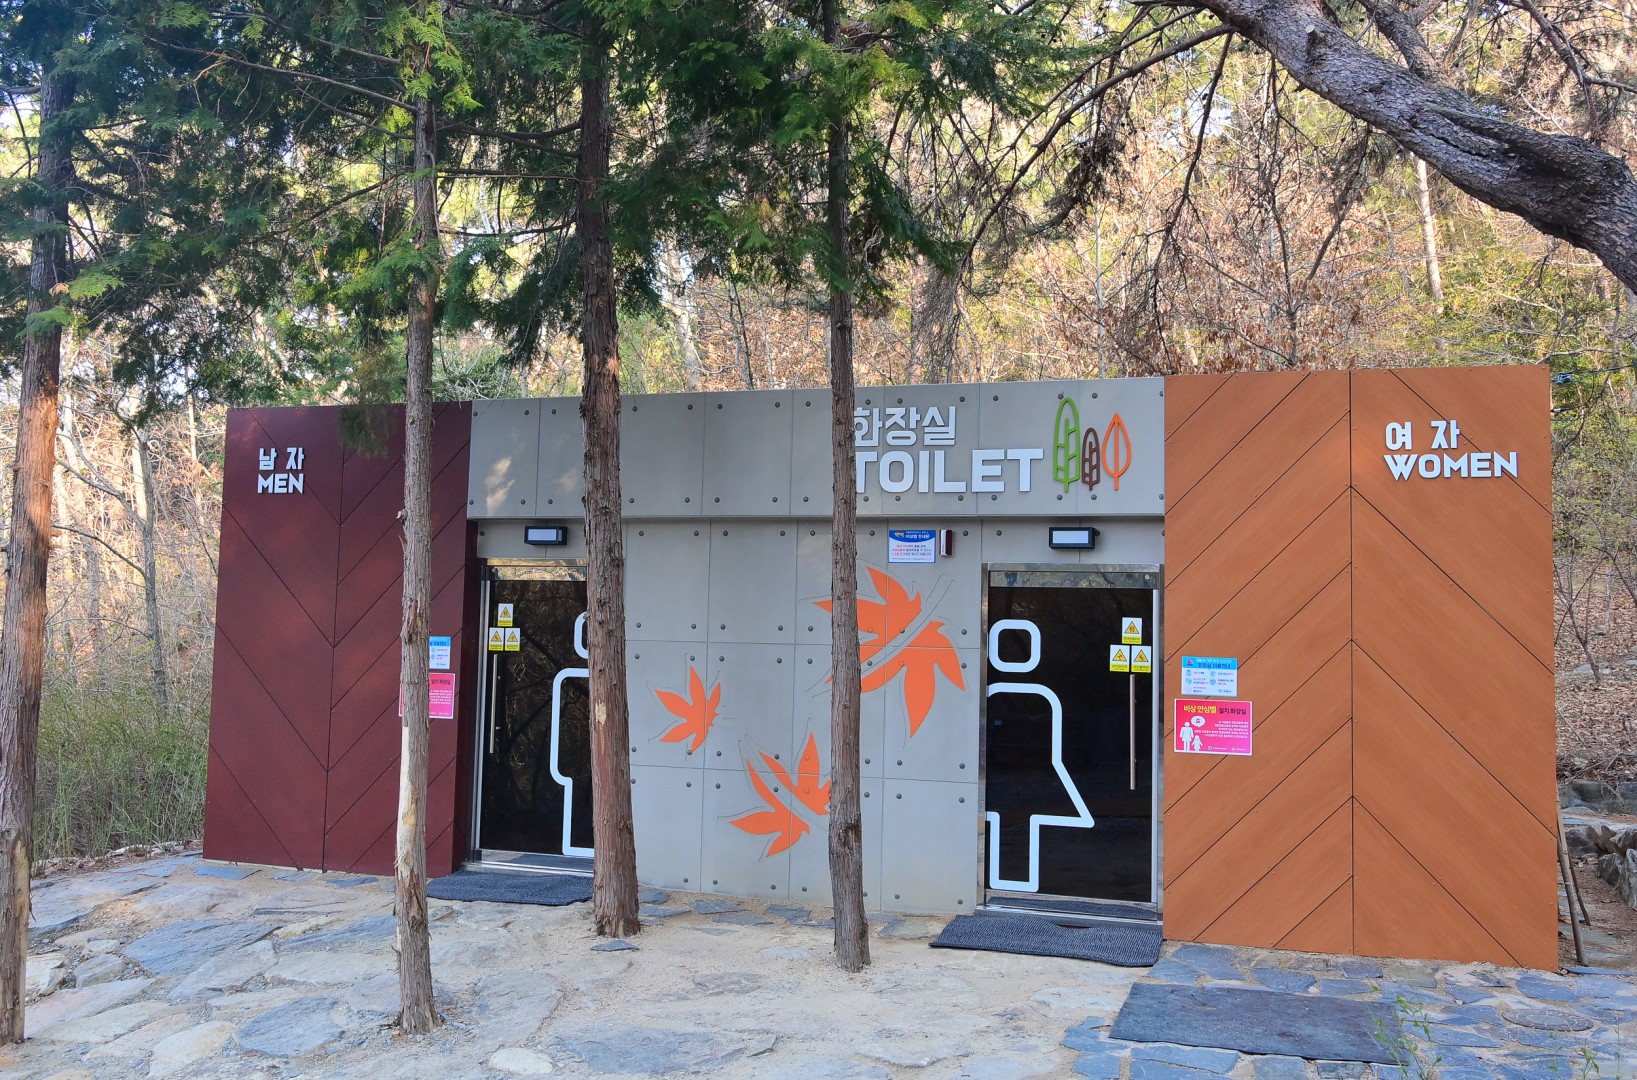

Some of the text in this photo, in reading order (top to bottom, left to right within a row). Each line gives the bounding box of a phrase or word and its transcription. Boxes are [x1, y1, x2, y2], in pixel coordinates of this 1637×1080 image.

[854, 405, 956, 447] 화장실
[257, 472, 304, 495] MEN
[855, 448, 1044, 493] TOILET
[1383, 450, 1518, 481] WOMEN
